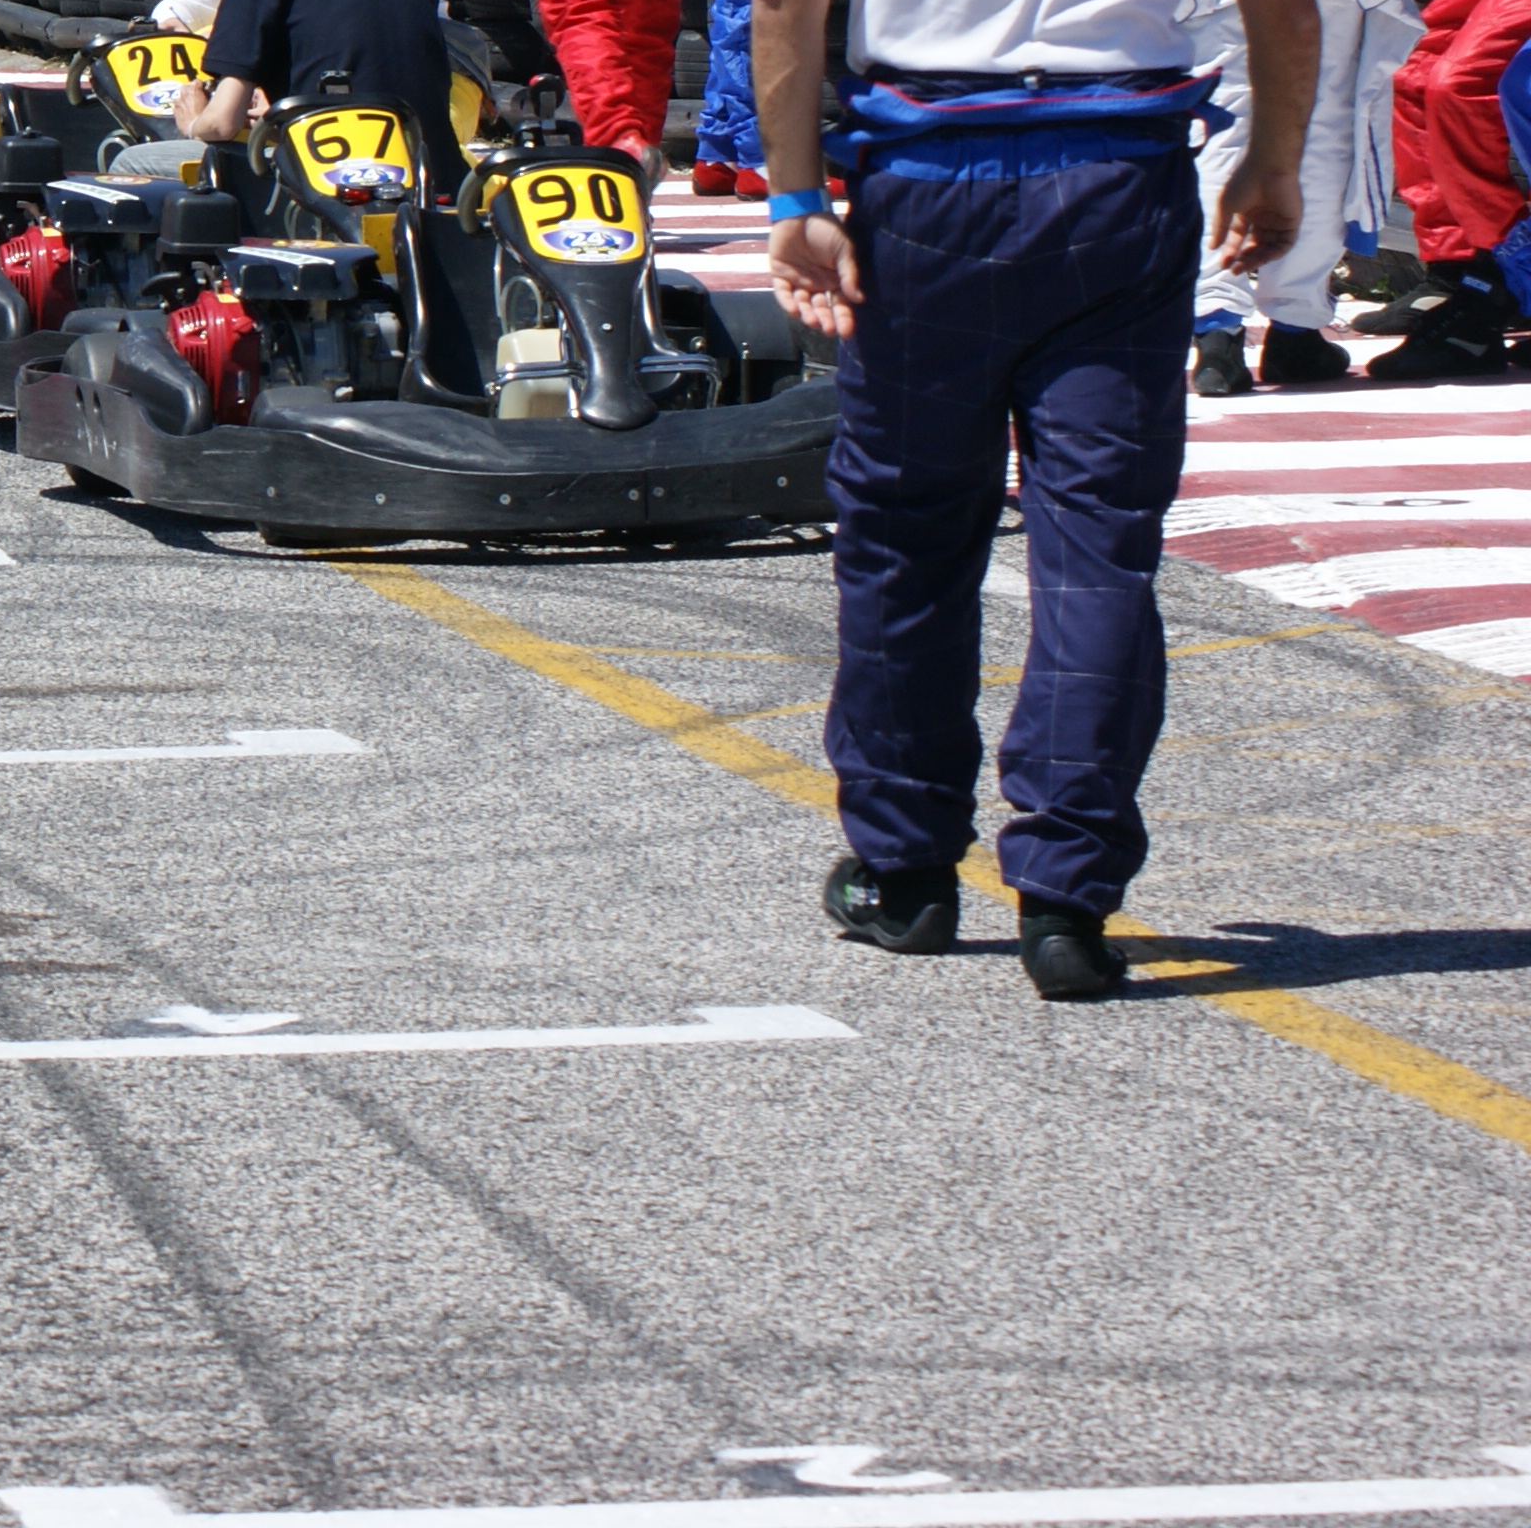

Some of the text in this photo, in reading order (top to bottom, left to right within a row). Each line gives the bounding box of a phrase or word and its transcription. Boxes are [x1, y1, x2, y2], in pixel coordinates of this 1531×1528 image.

[127, 43, 199, 88] 24
[305, 113, 396, 165] 67
[527, 173, 624, 229] 90
